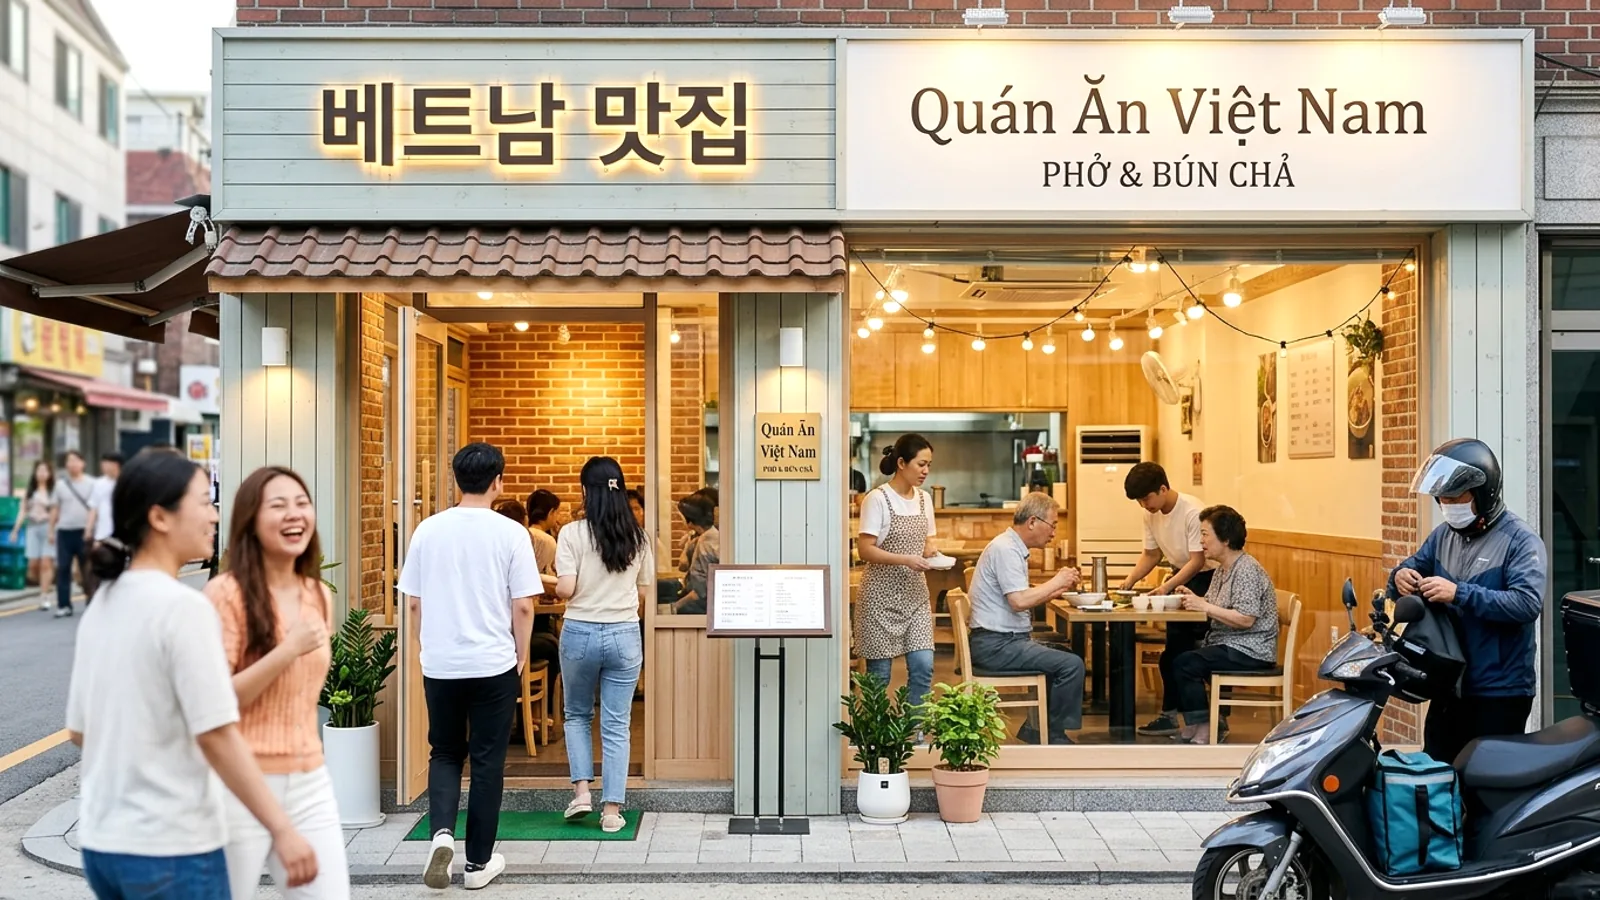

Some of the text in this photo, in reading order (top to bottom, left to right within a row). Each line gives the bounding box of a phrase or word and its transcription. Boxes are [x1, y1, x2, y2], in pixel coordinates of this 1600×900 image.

[322, 82, 748, 167] 베트남 맛집
[910, 73, 1428, 147] Quán Ăn Việt Nam
[1042, 152, 1295, 188] PHỞ & BÚN CHẢ
[761, 422, 794, 439] Quán
[761, 444, 816, 462] Việt Nam
